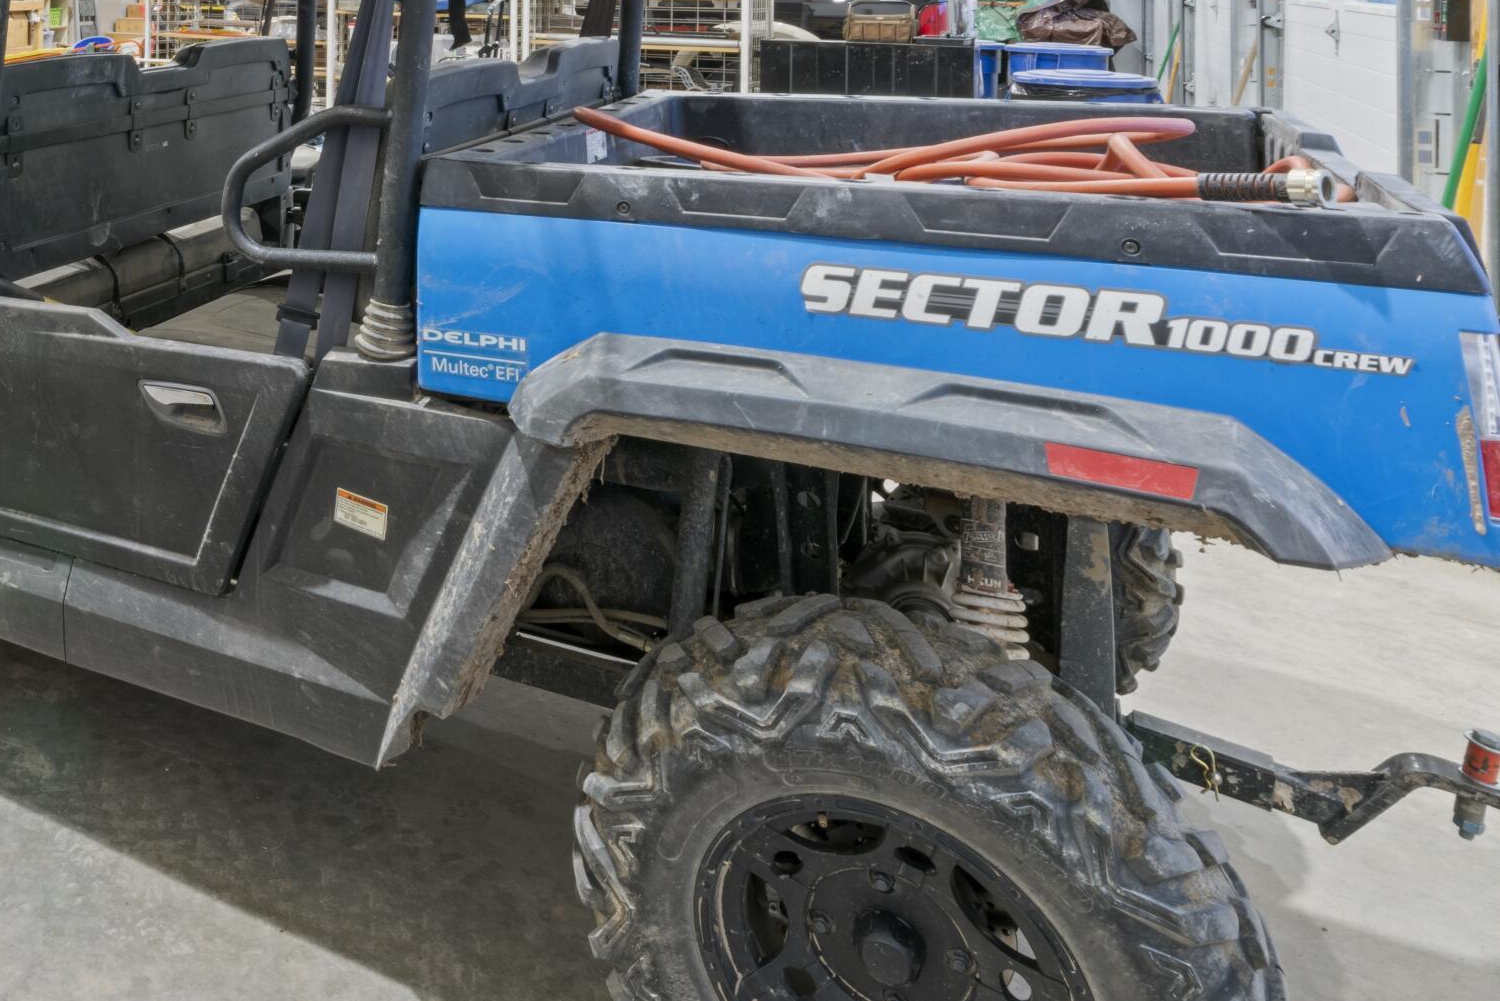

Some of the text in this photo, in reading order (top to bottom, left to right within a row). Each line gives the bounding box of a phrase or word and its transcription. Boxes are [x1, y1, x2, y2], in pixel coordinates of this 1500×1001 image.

[800, 264, 1414, 375] SECTOR 1000 CREW
[422, 328, 526, 352] DELPHI
[496, 366, 519, 382] EFI
